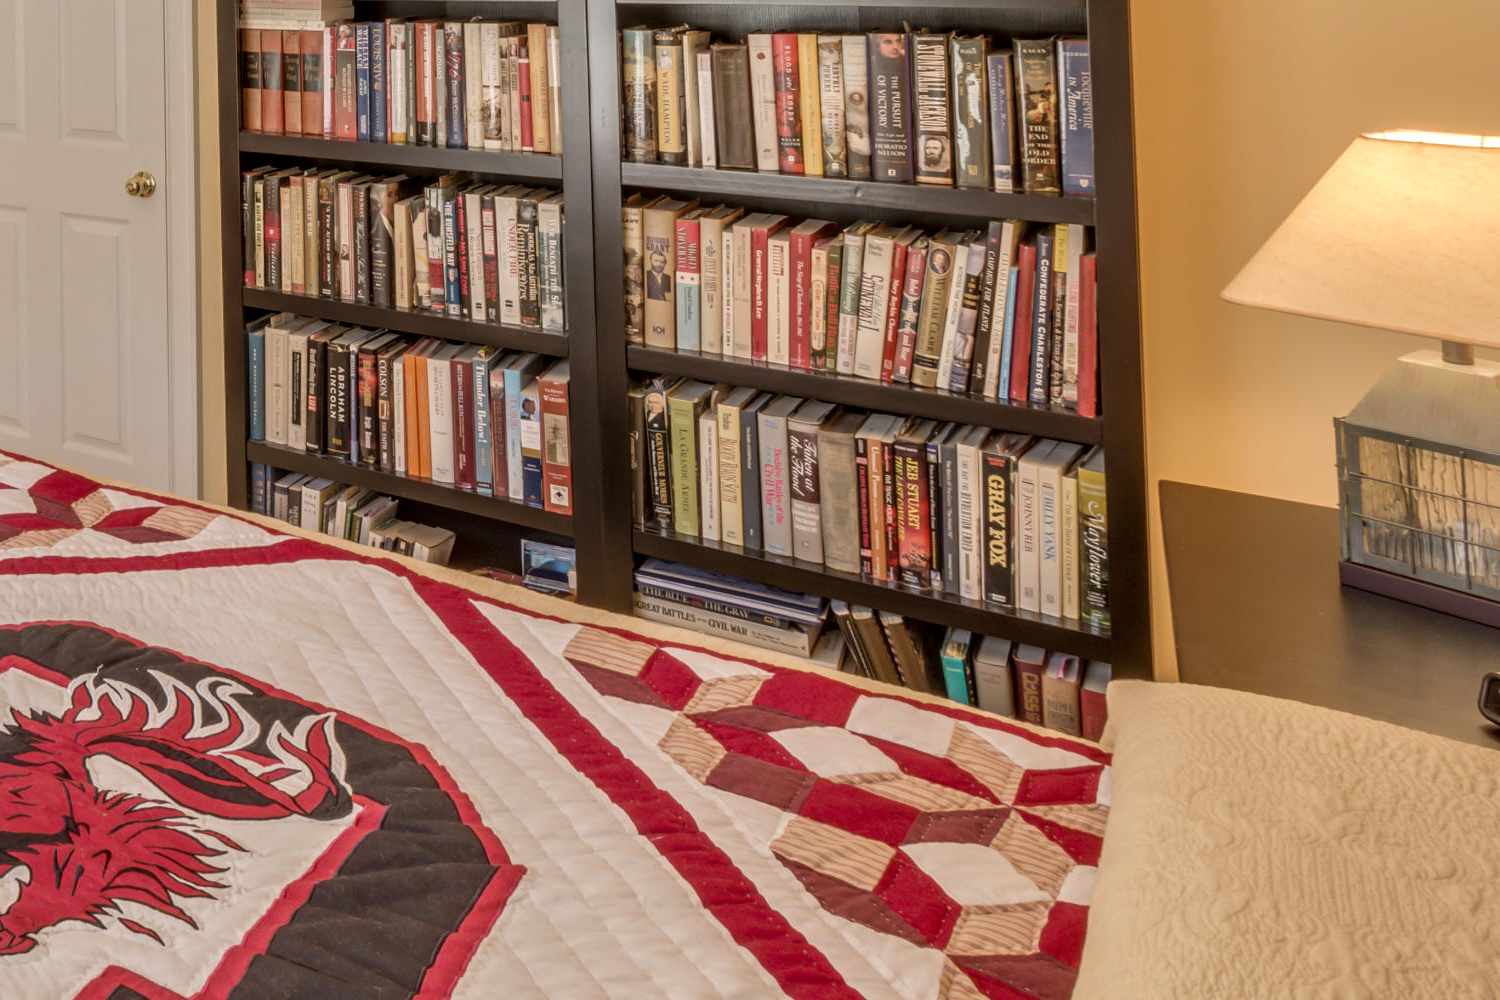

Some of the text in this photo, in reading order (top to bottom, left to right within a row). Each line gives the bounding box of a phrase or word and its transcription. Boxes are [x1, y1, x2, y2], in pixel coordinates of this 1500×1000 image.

[372, 28, 382, 81] LOUIS XIV
[445, 50, 462, 82] 1776
[824, 64, 832, 94] POWERS
[831, 62, 840, 94] EARTHLY
[916, 44, 948, 132] STONEWALL JACKSON
[661, 71, 672, 145] WADE HAMPTON
[876, 75, 888, 129] OF VICTORY
[891, 75, 902, 129] THE PURSUIT
[1067, 88, 1081, 131] America
[877, 150, 906, 158] NELSON
[1027, 133, 1049, 141] END
[445, 217, 456, 252] RUMSFELD
[507, 218, 518, 278] UNDER FIRE
[447, 252, 456, 267] WAY
[549, 239, 559, 275] BENEATH
[687, 242, 698, 271] MIGHTY
[985, 250, 997, 286] CAMPAIGN
[828, 264, 839, 294] Battle
[930, 276, 947, 319] WILLIAM
[980, 302, 991, 332] ATLANTA
[1034, 258, 1050, 387] CONFEDERATE CHARLESTON
[329, 367, 337, 419] LINCOLN
[337, 366, 346, 423] ABRAHAM
[379, 359, 388, 397] COLSON
[475, 364, 489, 444] Thunder Below!
[655, 432, 669, 505] GOUVERNEUR MORRIS
[773, 448, 784, 479] Decisive
[789, 435, 805, 498] the Flood
[802, 438, 817, 494] Taken at
[764, 463, 776, 509] Civil War
[775, 479, 785, 504] Battles
[906, 456, 920, 529] JEB STUART
[962, 531, 974, 553] ENDED
[988, 474, 1008, 567] GRAY FOX
[1024, 493, 1035, 554] JOHNNY REB
[1043, 496, 1056, 561] BILLY YANK
[1083, 500, 1107, 589] Mayflower
[636, 600, 748, 638] GREAT BATTLES CIVIL WAR
[664, 589, 690, 605] BLUE
[723, 605, 750, 620] GRAY
